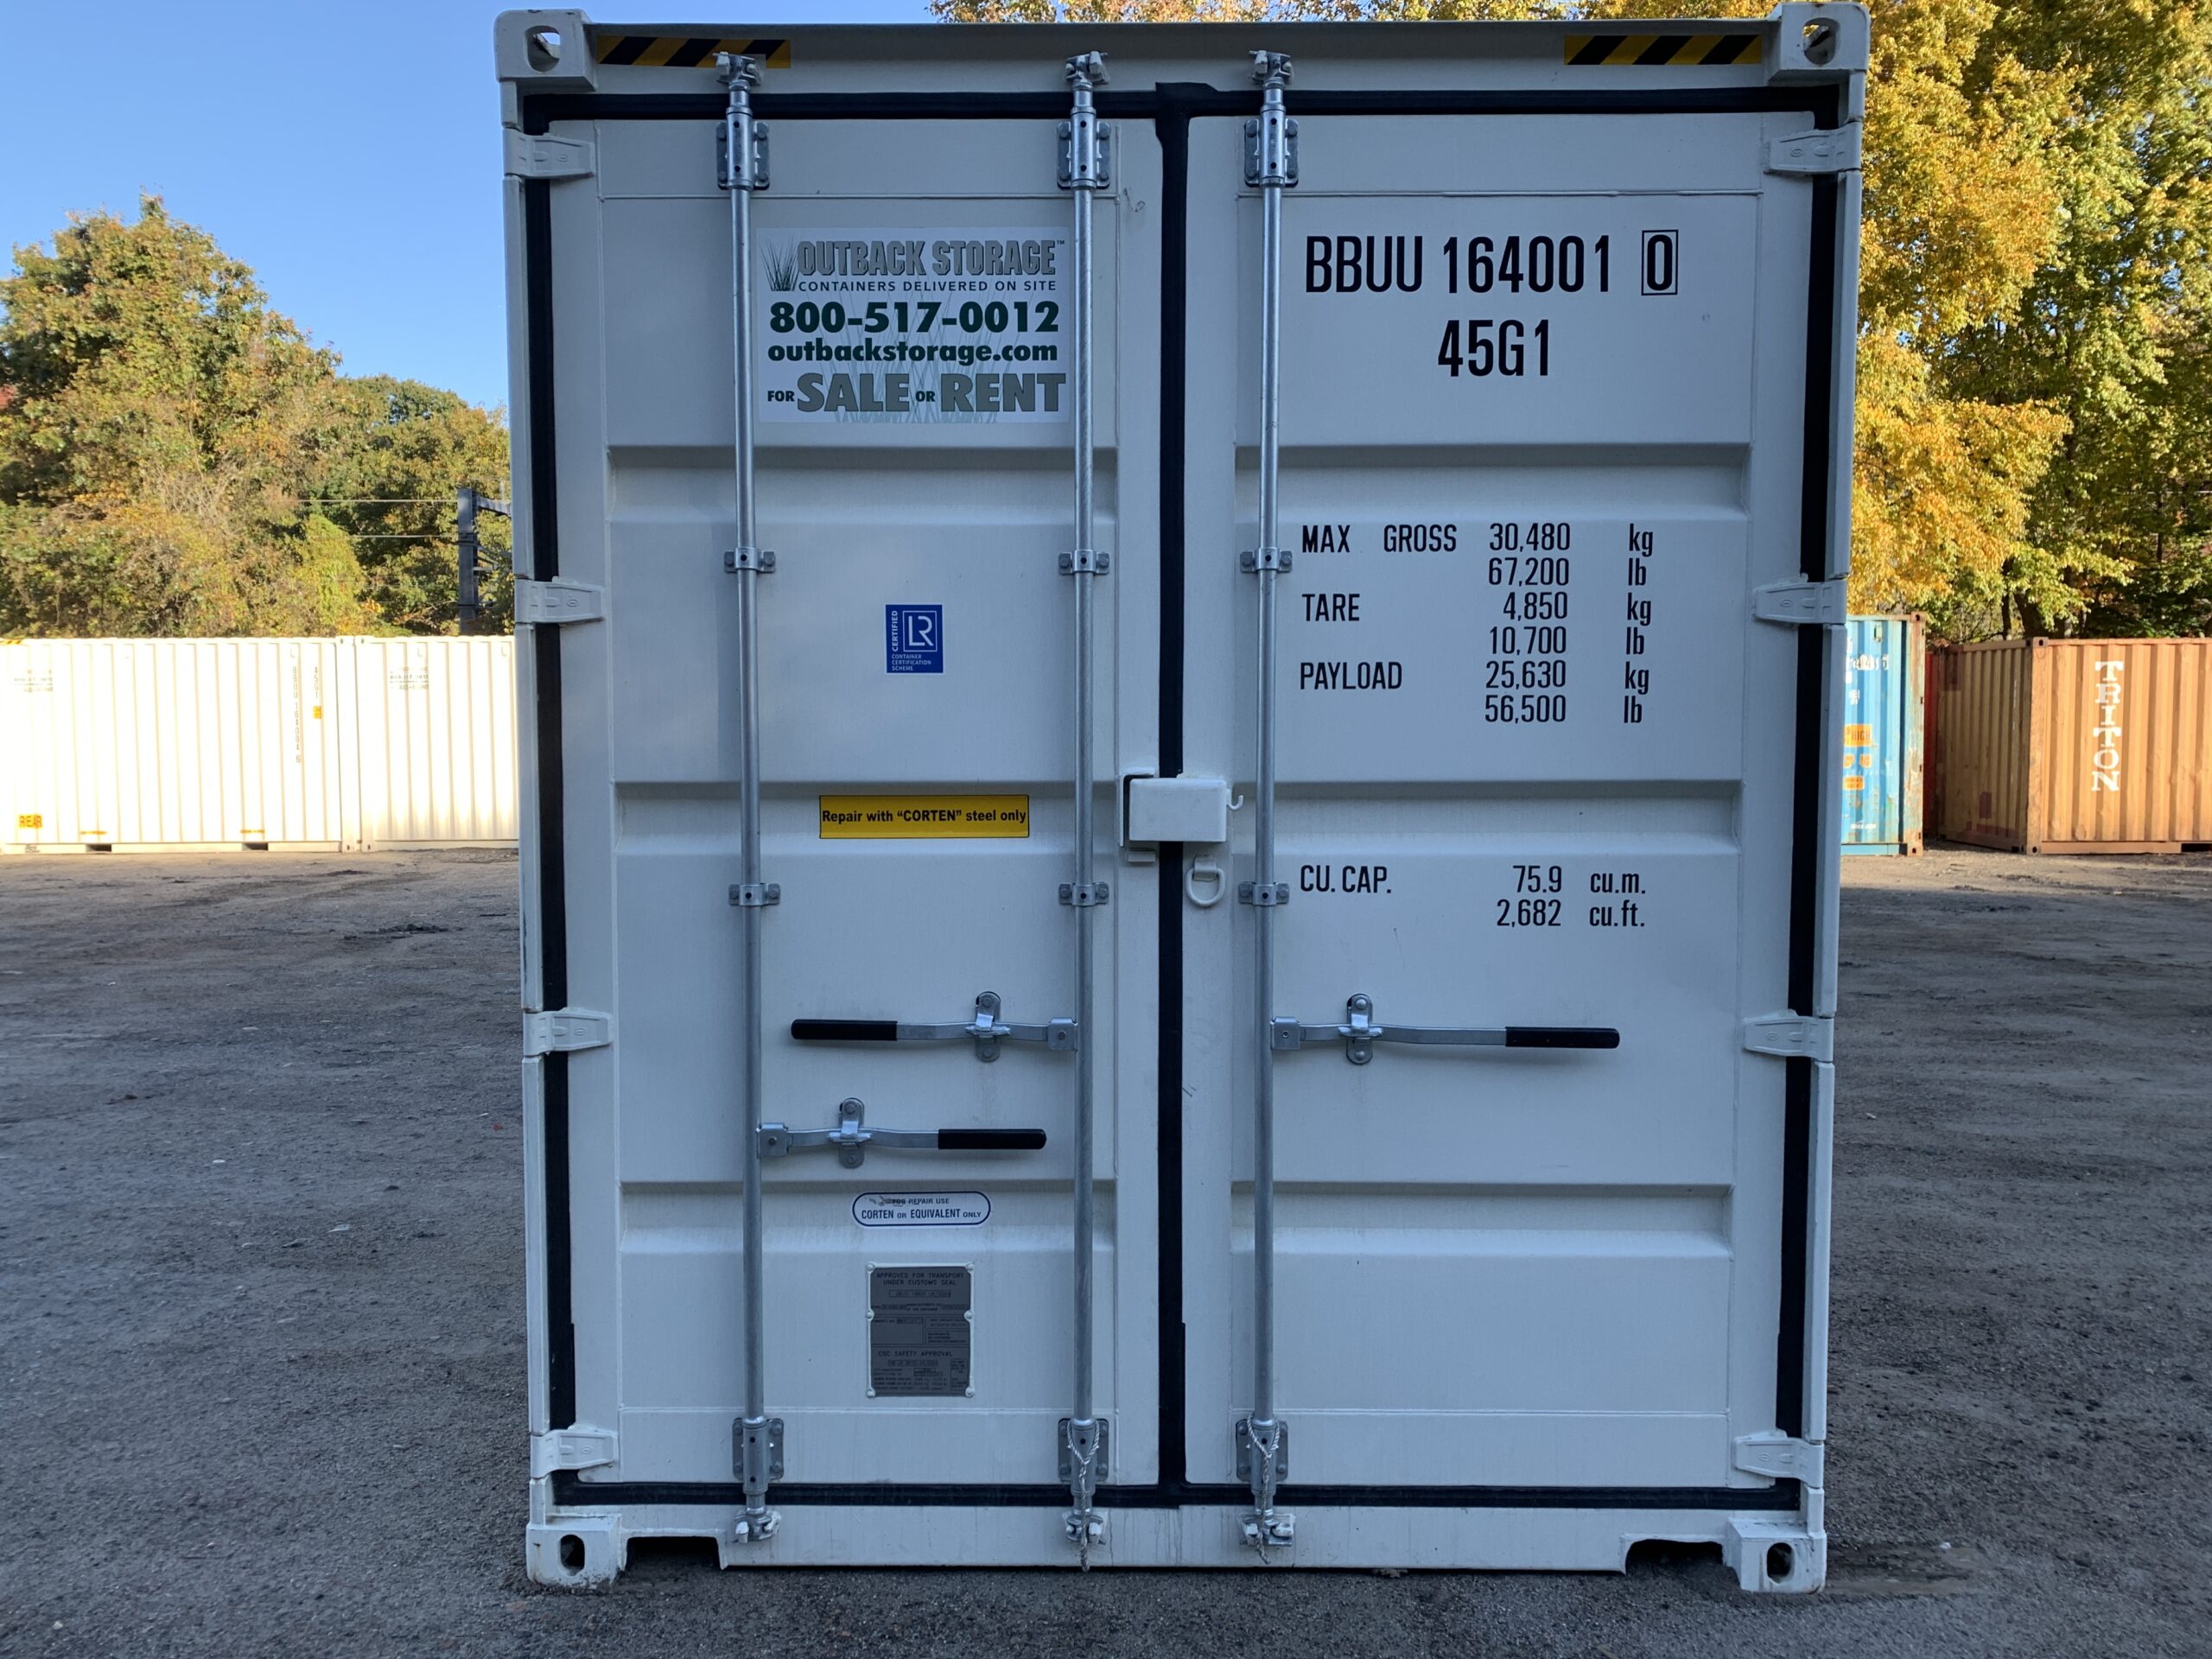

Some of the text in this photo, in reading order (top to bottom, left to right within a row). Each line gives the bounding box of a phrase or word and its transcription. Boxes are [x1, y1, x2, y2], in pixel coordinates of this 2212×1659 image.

[797, 240, 926, 276] OUTBACK
[931, 239, 1057, 276] STORAGE
[1305, 233, 1674, 294] BBUU 164001 0
[798, 280, 1057, 292] CONTAINERS DELIVERED ON SITE
[769, 301, 1059, 334] 800-517-0012
[767, 337, 1058, 366] outbackstorage.com
[1437, 318, 1549, 378] 45G1
[767, 372, 1066, 413] FOR SALE OR RENT
[1301, 522, 1654, 557] MAX GROSS 30,480 kg
[1488, 557, 1647, 588] 67,200 lb
[1301, 591, 1652, 626] TARE 4,850 kg
[908, 615, 934, 646] LR
[1489, 626, 1644, 656] 10,700 lb
[1300, 659, 1649, 696] PAYLOAD 25,630 kg
[1484, 694, 1643, 724] 56,500 lb
[2091, 660, 2125, 792] TRITON
[19, 815, 42, 829] REAR
[822, 810, 862, 824] Repair
[866, 810, 893, 822] with
[965, 810, 996, 821] steel
[1000, 809, 1027, 823] only
[1512, 865, 1563, 893] 75.9
[1589, 871, 1646, 894] cu.m.
[1496, 899, 1645, 928] 2,682 cu.ft.
[861, 1210, 893, 1220] CORTEN
[910, 1209, 961, 1219] EQUIVALENT
